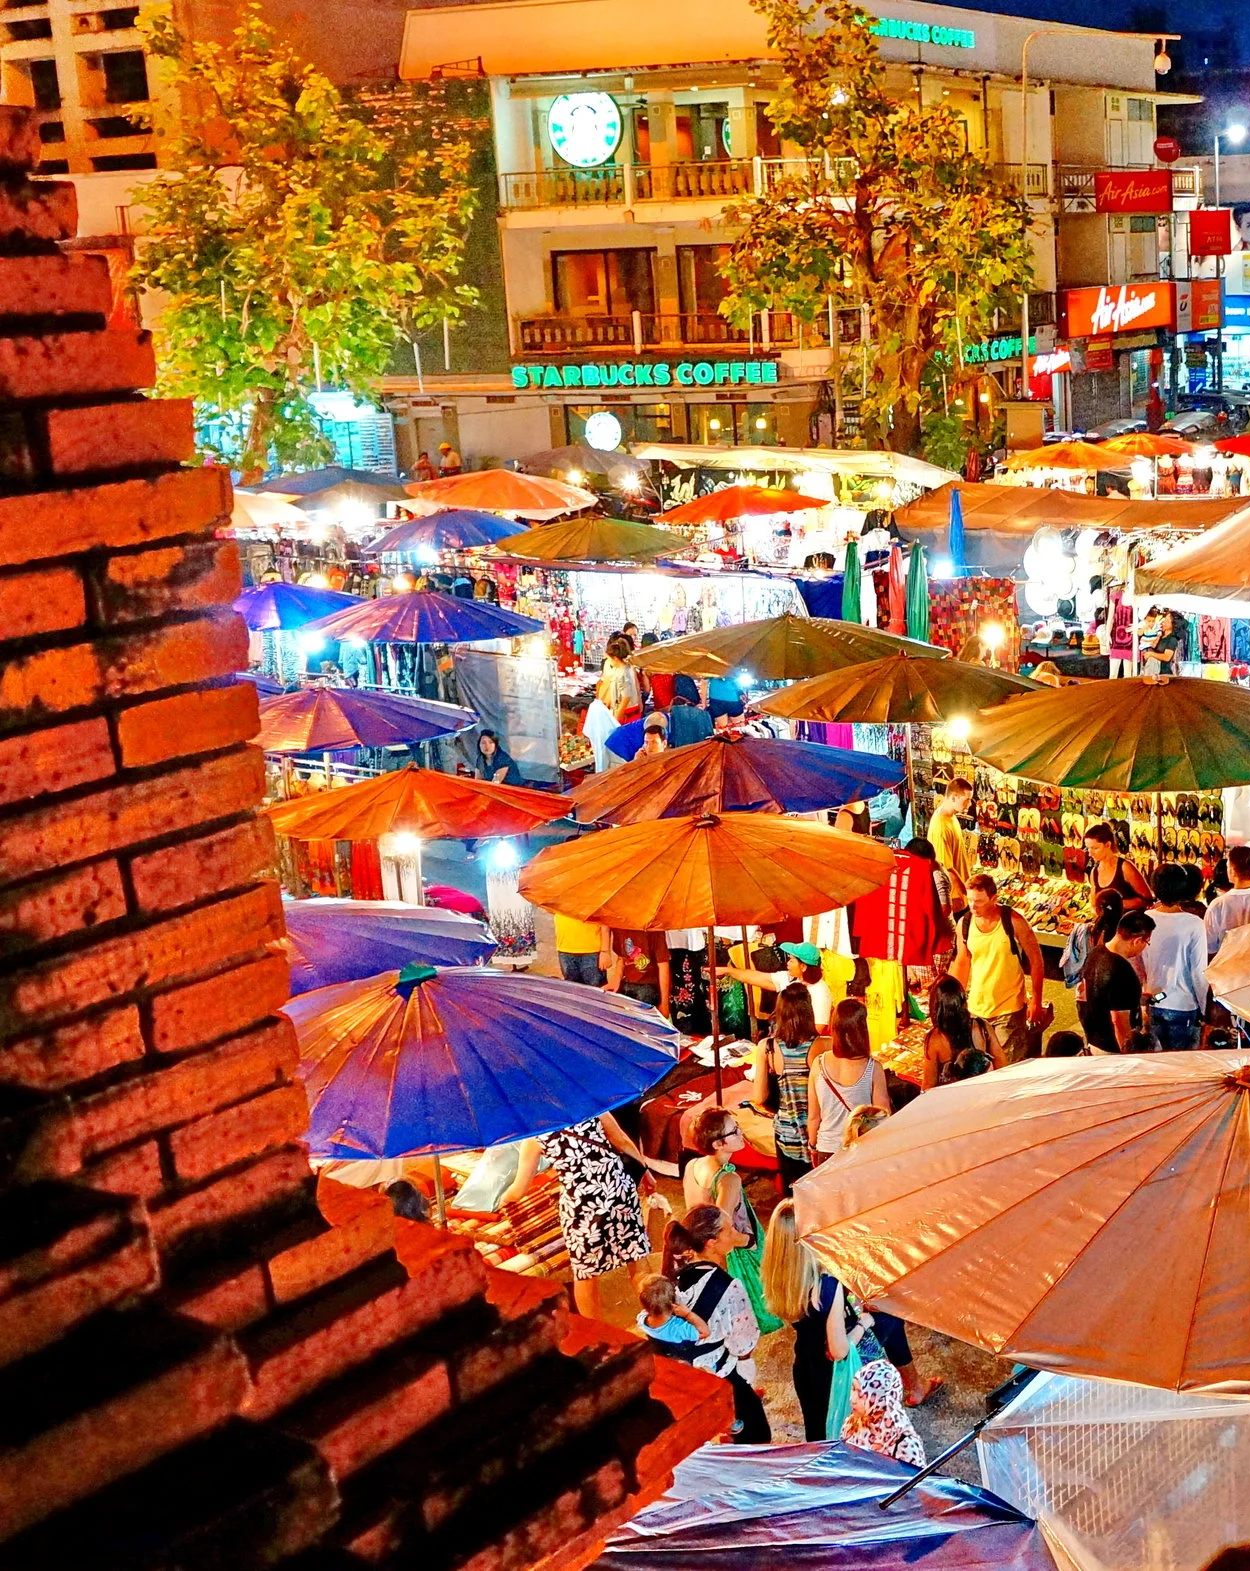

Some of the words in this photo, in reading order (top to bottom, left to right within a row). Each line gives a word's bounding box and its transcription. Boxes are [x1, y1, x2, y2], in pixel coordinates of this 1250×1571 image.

[931, 25, 975, 49] COFFEE
[990, 336, 1037, 361] COFFE
[511, 362, 671, 388] STARBUCKS
[676, 362, 778, 385] COFFEE
